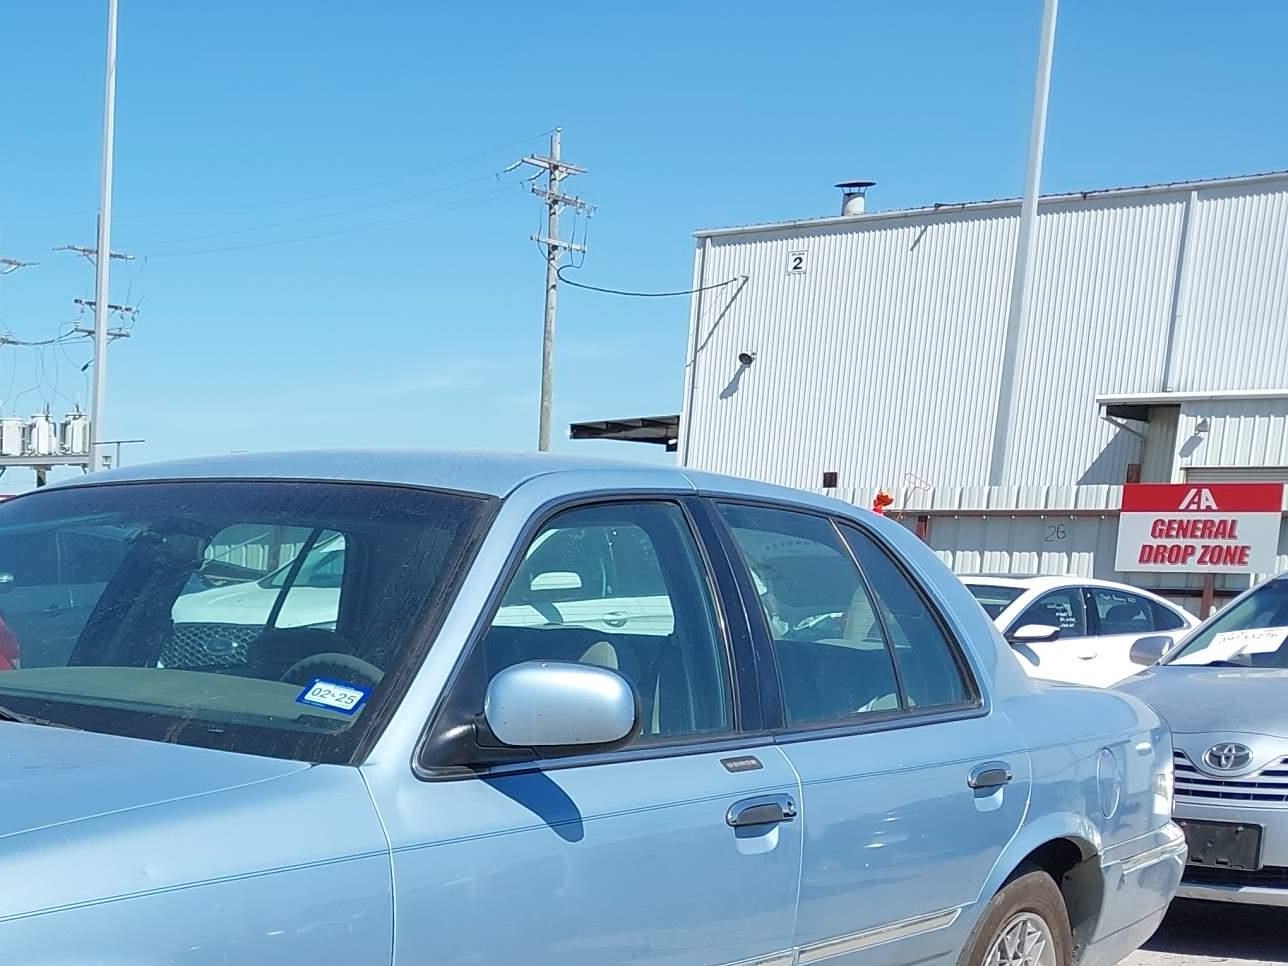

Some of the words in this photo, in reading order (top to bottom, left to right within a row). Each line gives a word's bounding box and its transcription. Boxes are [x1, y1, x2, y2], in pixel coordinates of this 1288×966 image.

[792, 256, 803, 270] 2
[1150, 518, 1239, 540] GENERAL
[1138, 544, 1196, 566] DROP
[1197, 545, 1252, 567] ZONE
